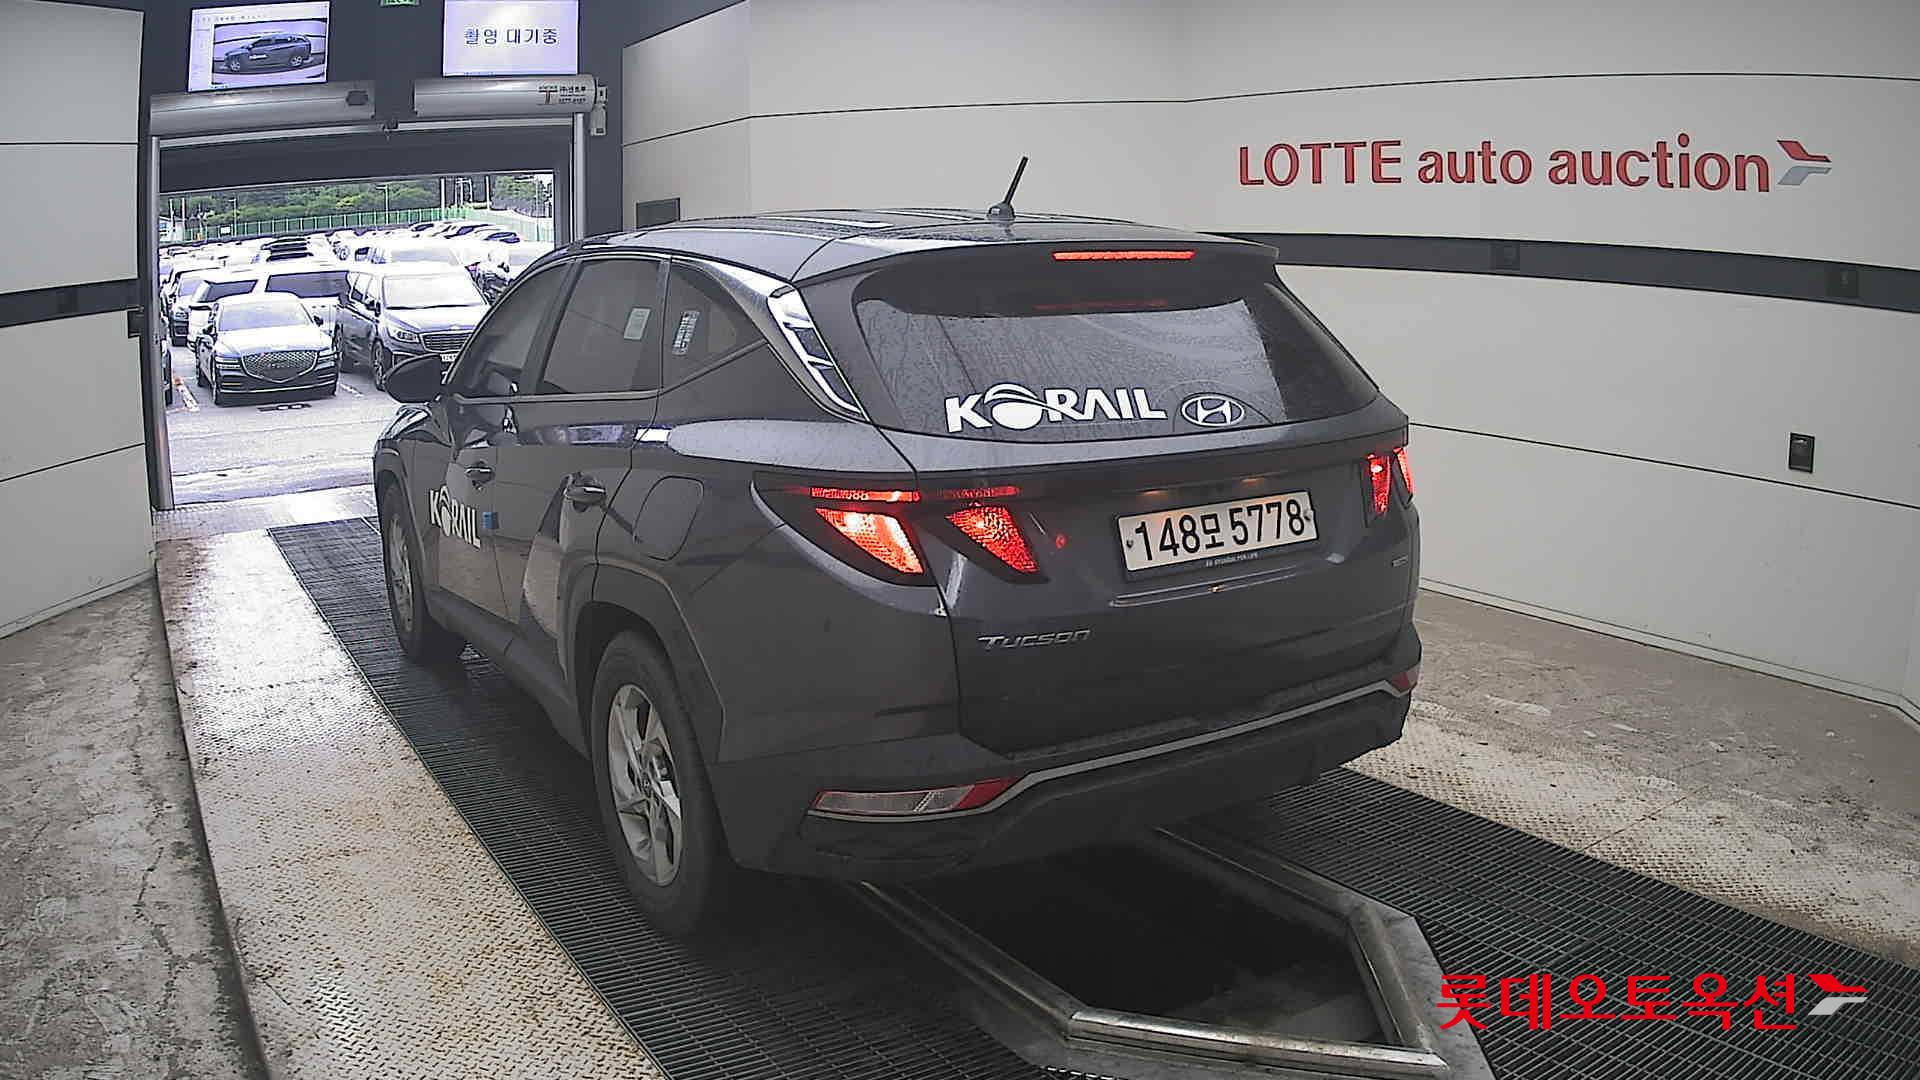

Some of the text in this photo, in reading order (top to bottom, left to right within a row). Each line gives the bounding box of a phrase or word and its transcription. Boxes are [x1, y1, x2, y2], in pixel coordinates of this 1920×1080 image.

[506, 28, 558, 45] 대기중
[1239, 133, 1770, 193] LOTTE auto auction
[945, 382, 1169, 433] KORAIL
[429, 486, 481, 549] KORAIL
[1135, 498, 1305, 561] 148모 5778
